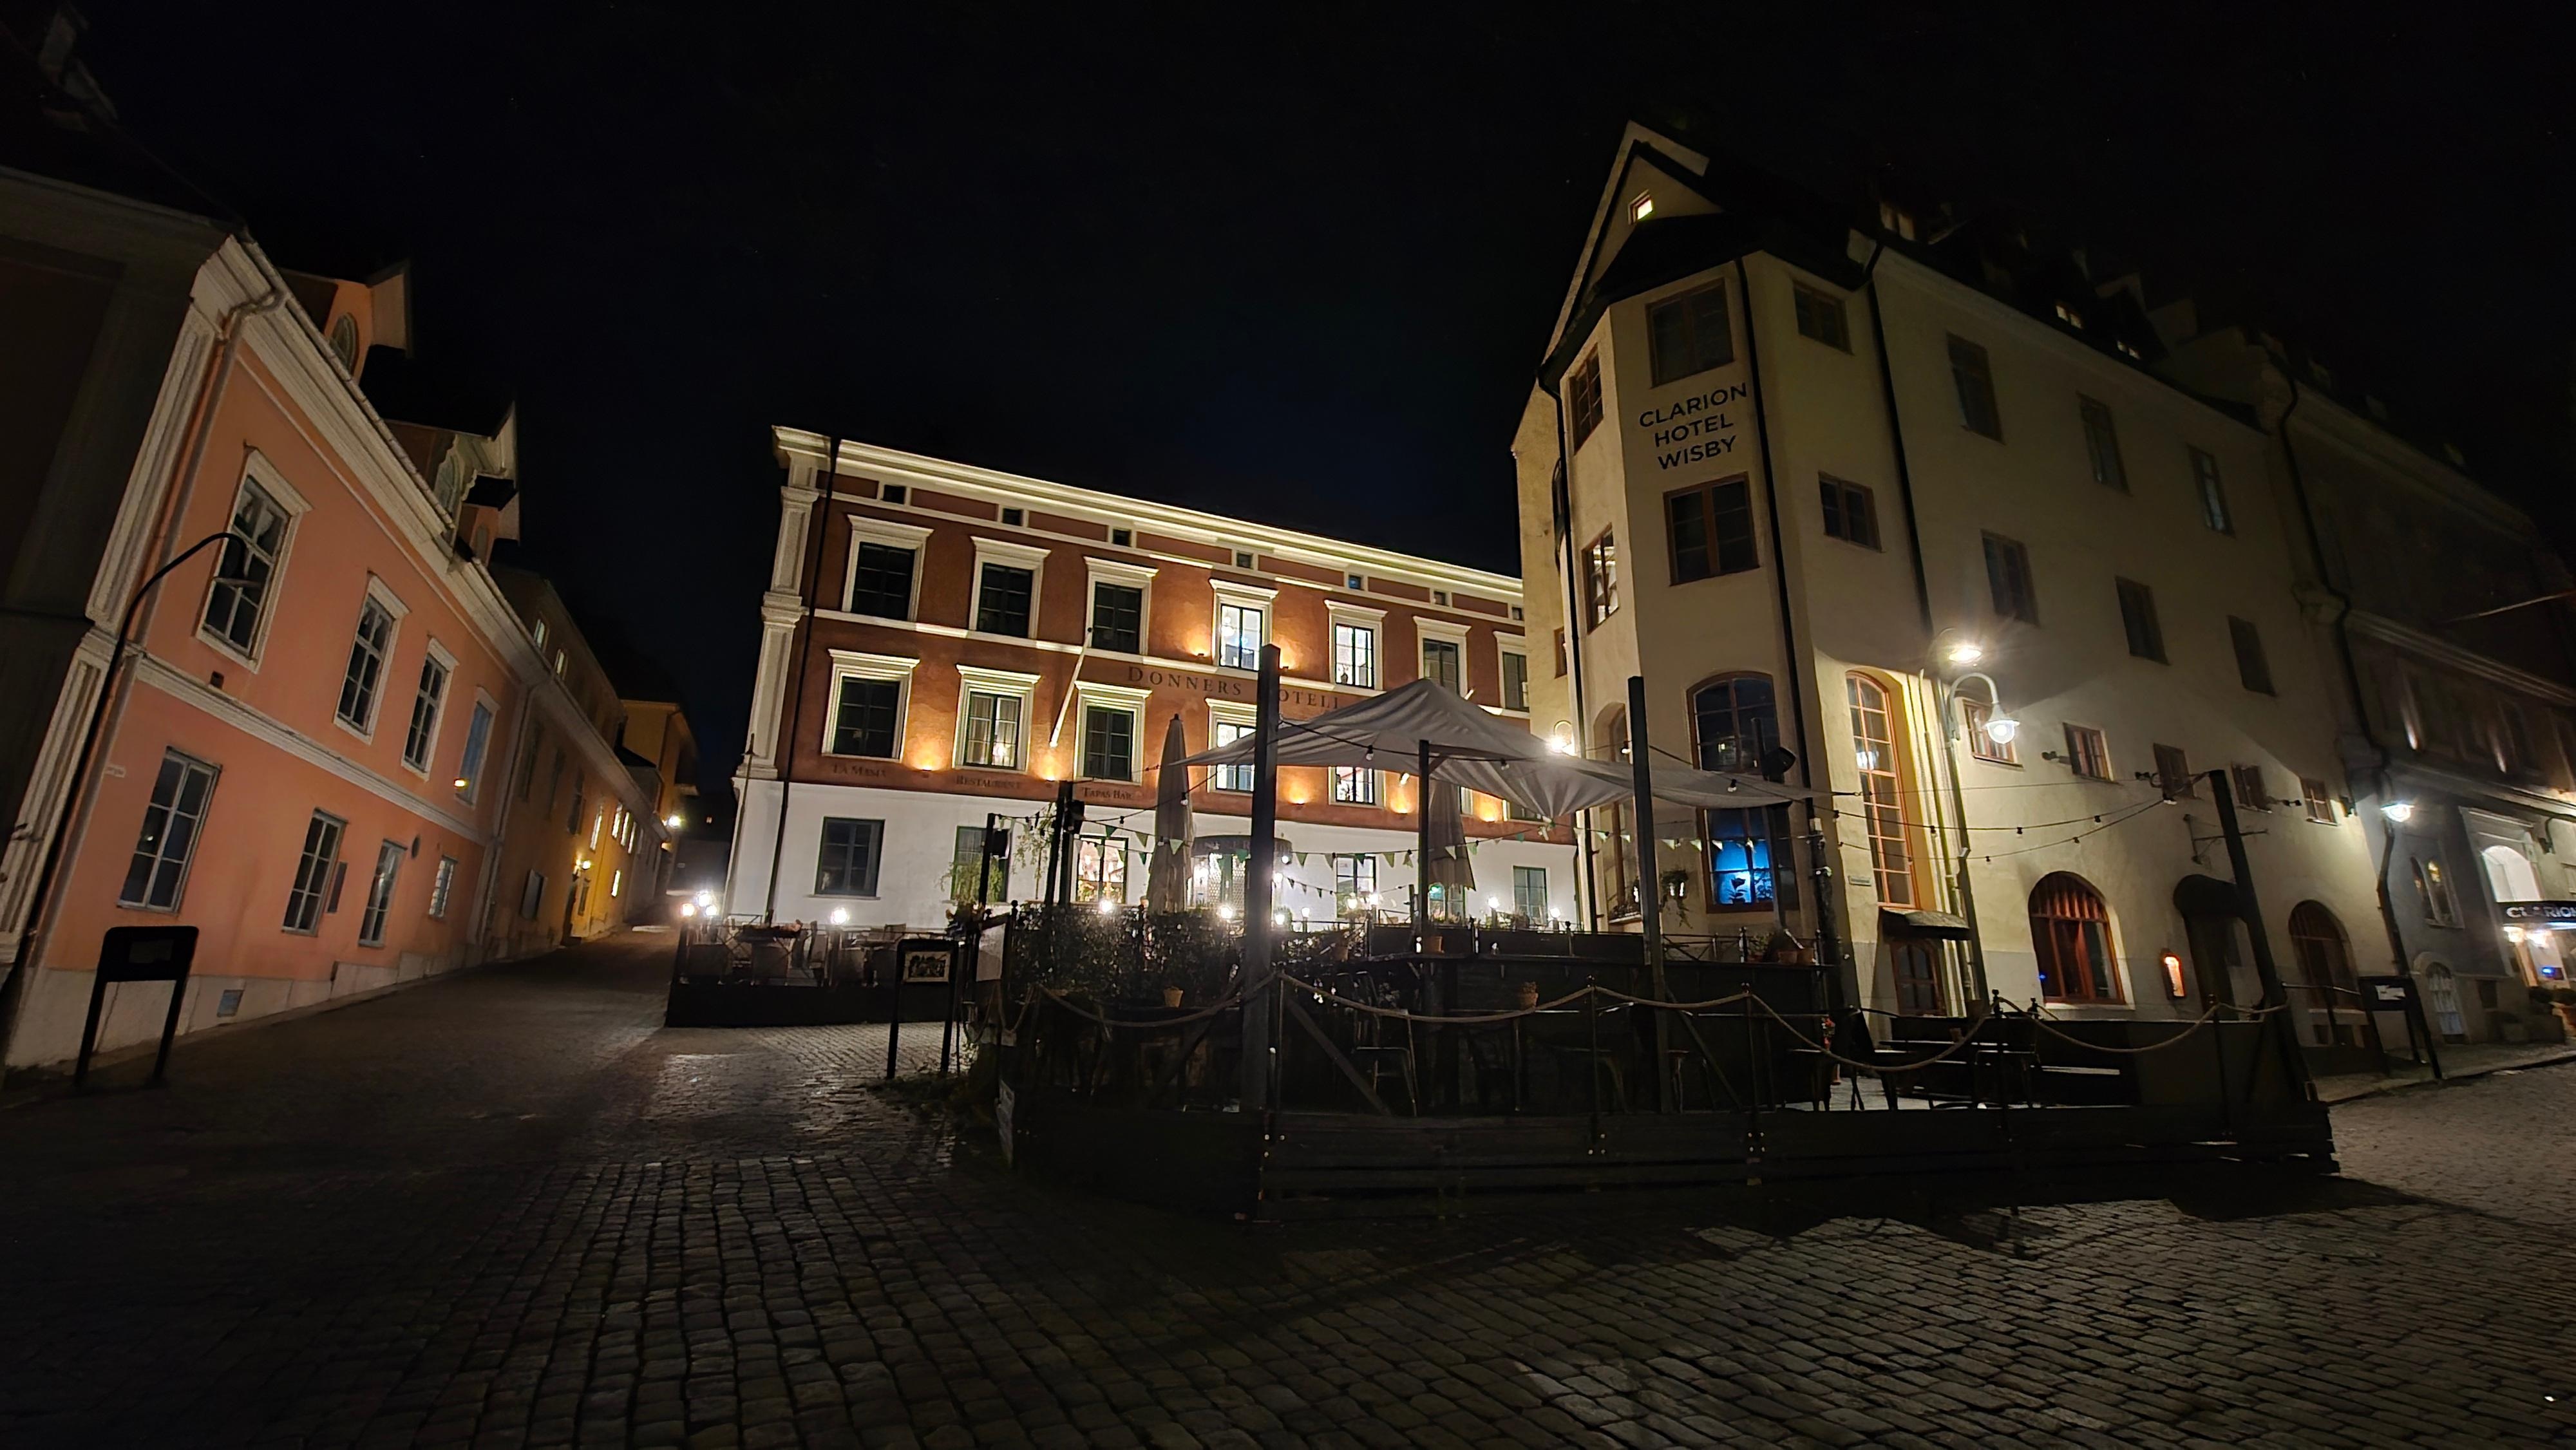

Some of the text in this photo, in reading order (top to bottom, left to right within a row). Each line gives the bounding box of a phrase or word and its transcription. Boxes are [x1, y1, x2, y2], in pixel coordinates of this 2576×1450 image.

[1639, 382, 1747, 428] CLARION
[1654, 413, 1734, 447] HOTEL
[1658, 435, 1737, 470] WISBY
[1128, 666, 1338, 709] DONNERS OTELL
